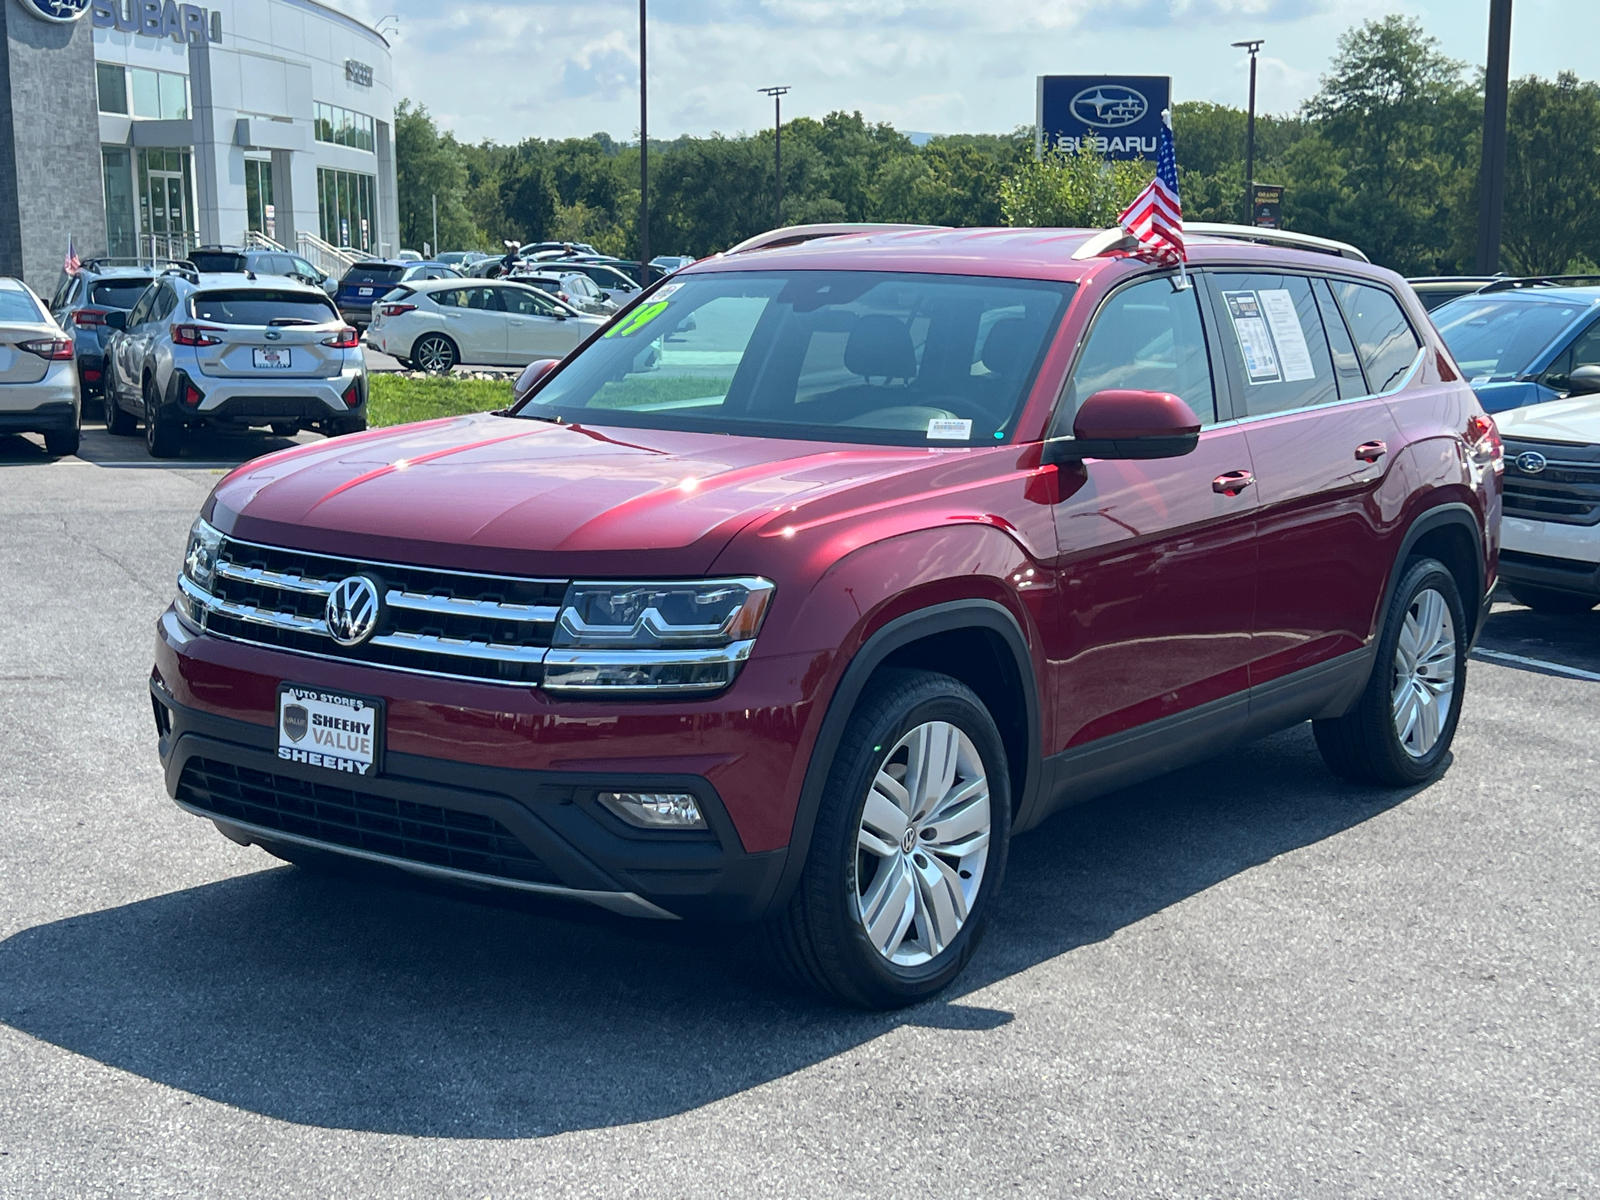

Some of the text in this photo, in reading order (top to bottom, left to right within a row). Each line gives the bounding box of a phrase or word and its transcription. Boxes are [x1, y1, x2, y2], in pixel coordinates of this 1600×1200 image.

[92, 0, 222, 44] SUBARU
[604, 301, 669, 338] 19
[288, 688, 364, 708] AUTO STORES
[312, 713, 370, 735] SHEEHY
[312, 728, 370, 754] VALUE
[278, 747, 370, 775] SHEEHY
